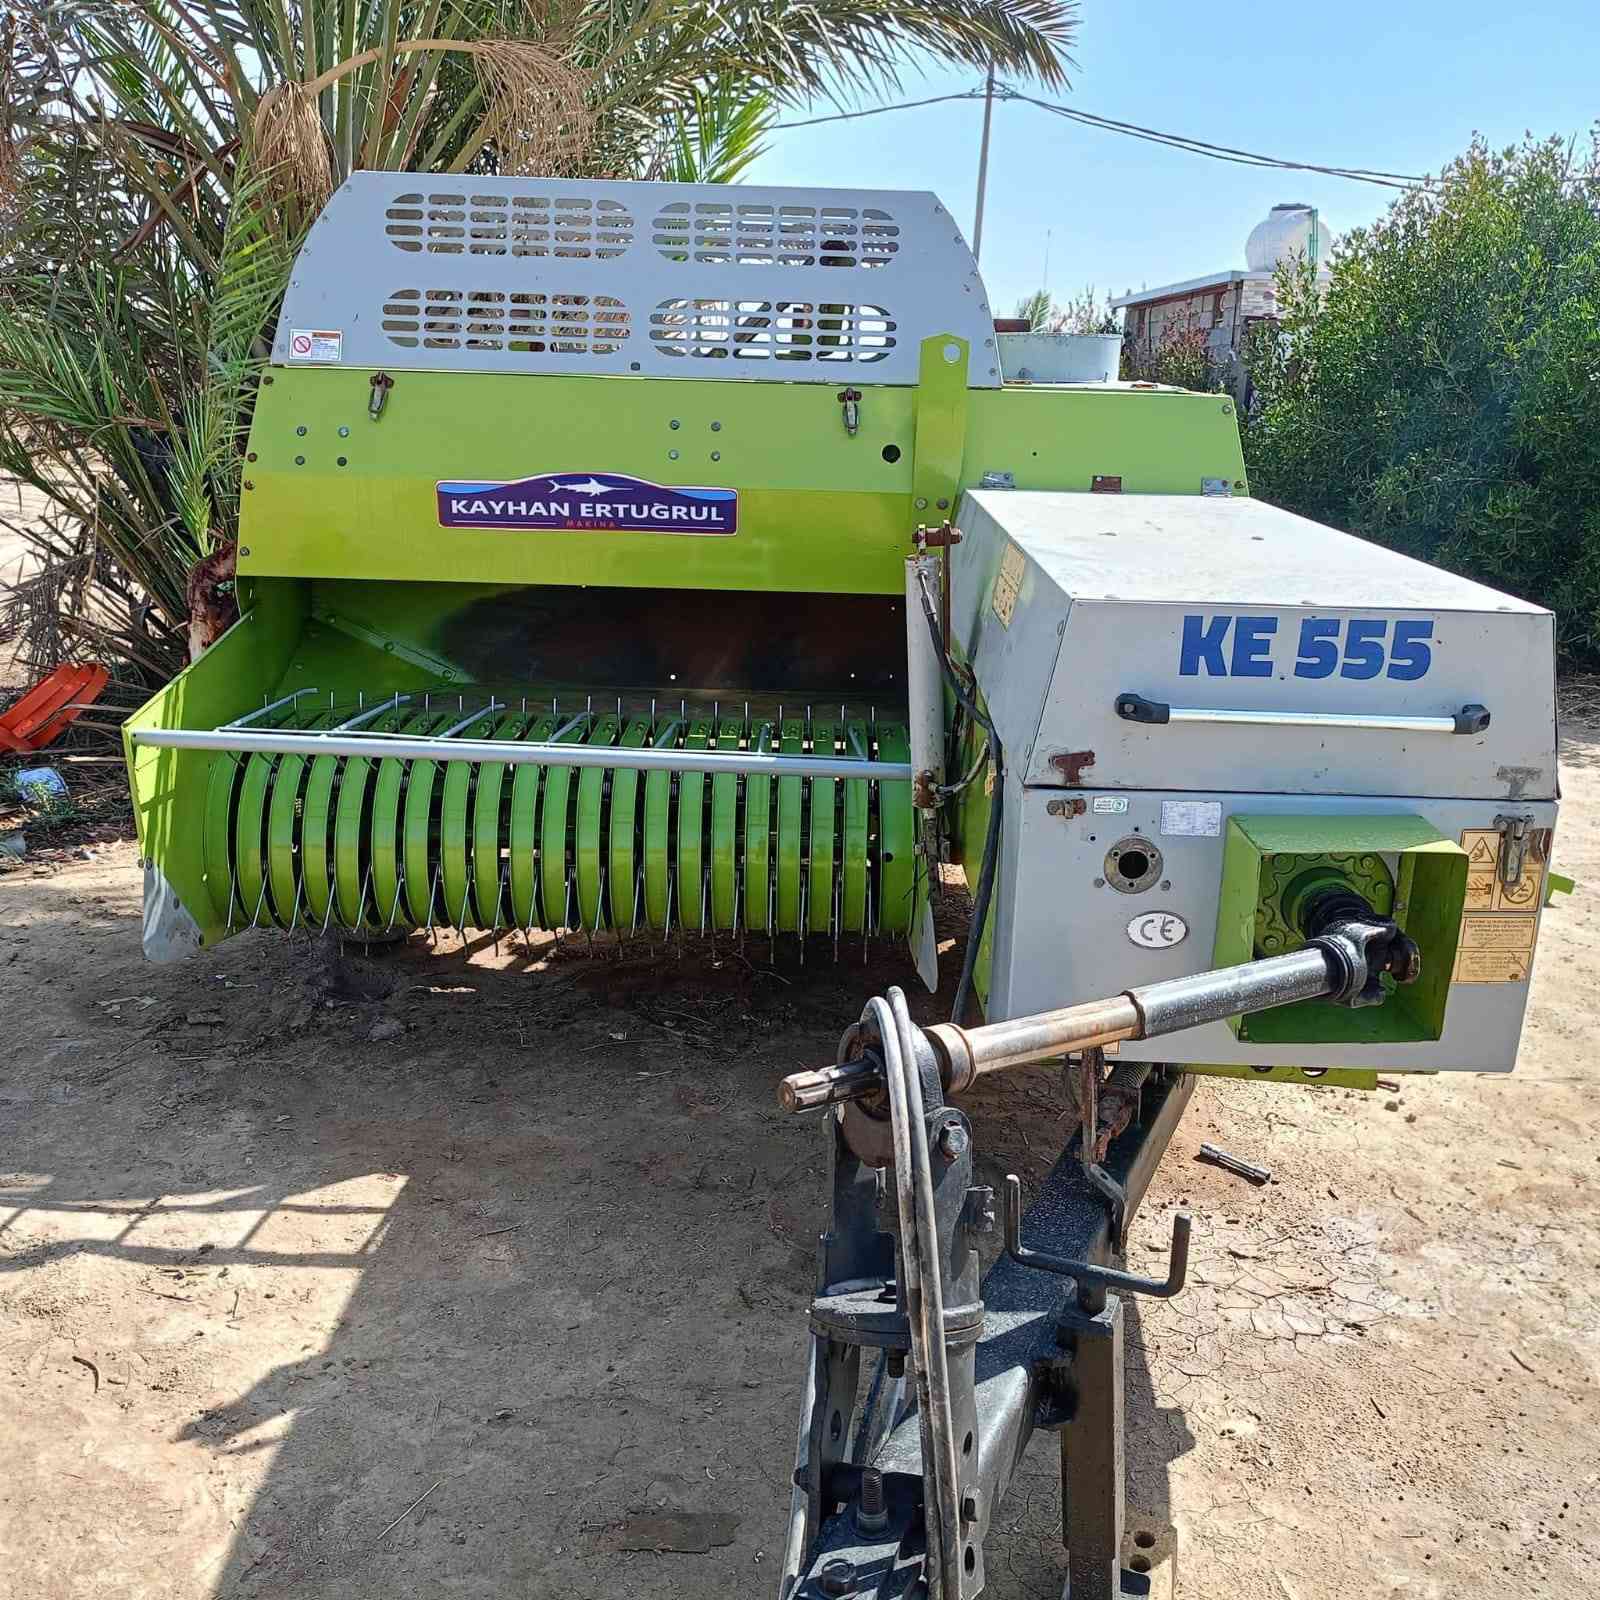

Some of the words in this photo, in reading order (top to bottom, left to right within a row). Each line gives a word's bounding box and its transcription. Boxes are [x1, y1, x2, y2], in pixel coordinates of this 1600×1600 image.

[451, 499, 570, 517] KAYHAN
[580, 502, 724, 521] ERTUĞRUL
[1179, 615, 1279, 678] KE
[1294, 618, 1434, 681] 555
[1140, 916, 1175, 942] CE
